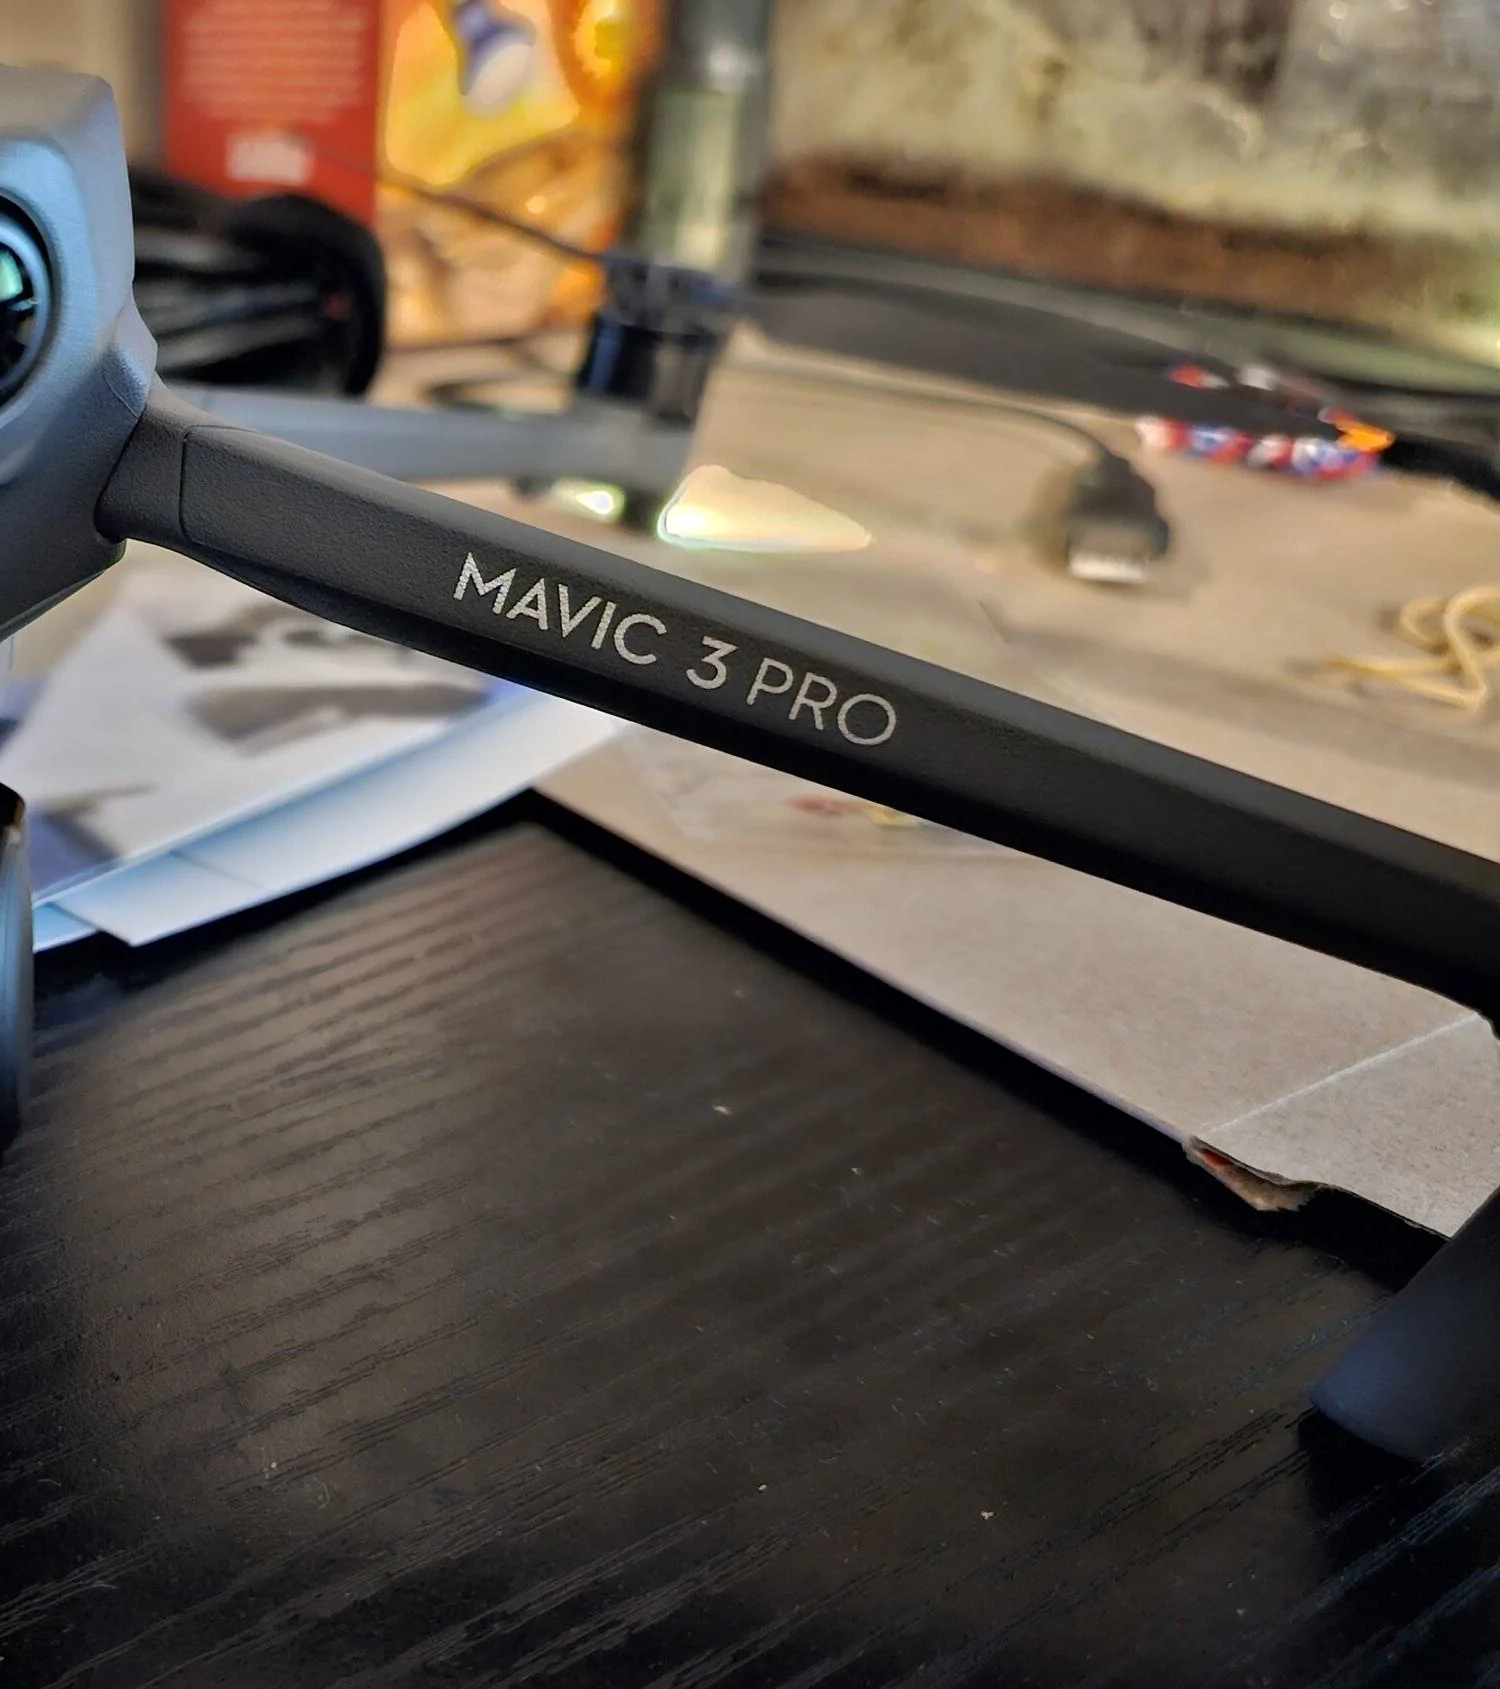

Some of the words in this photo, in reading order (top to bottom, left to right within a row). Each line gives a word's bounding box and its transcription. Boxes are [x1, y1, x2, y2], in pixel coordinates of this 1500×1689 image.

[453, 552, 667, 665] MAVIC
[686, 636, 738, 690] 3
[746, 658, 897, 746] PRO
